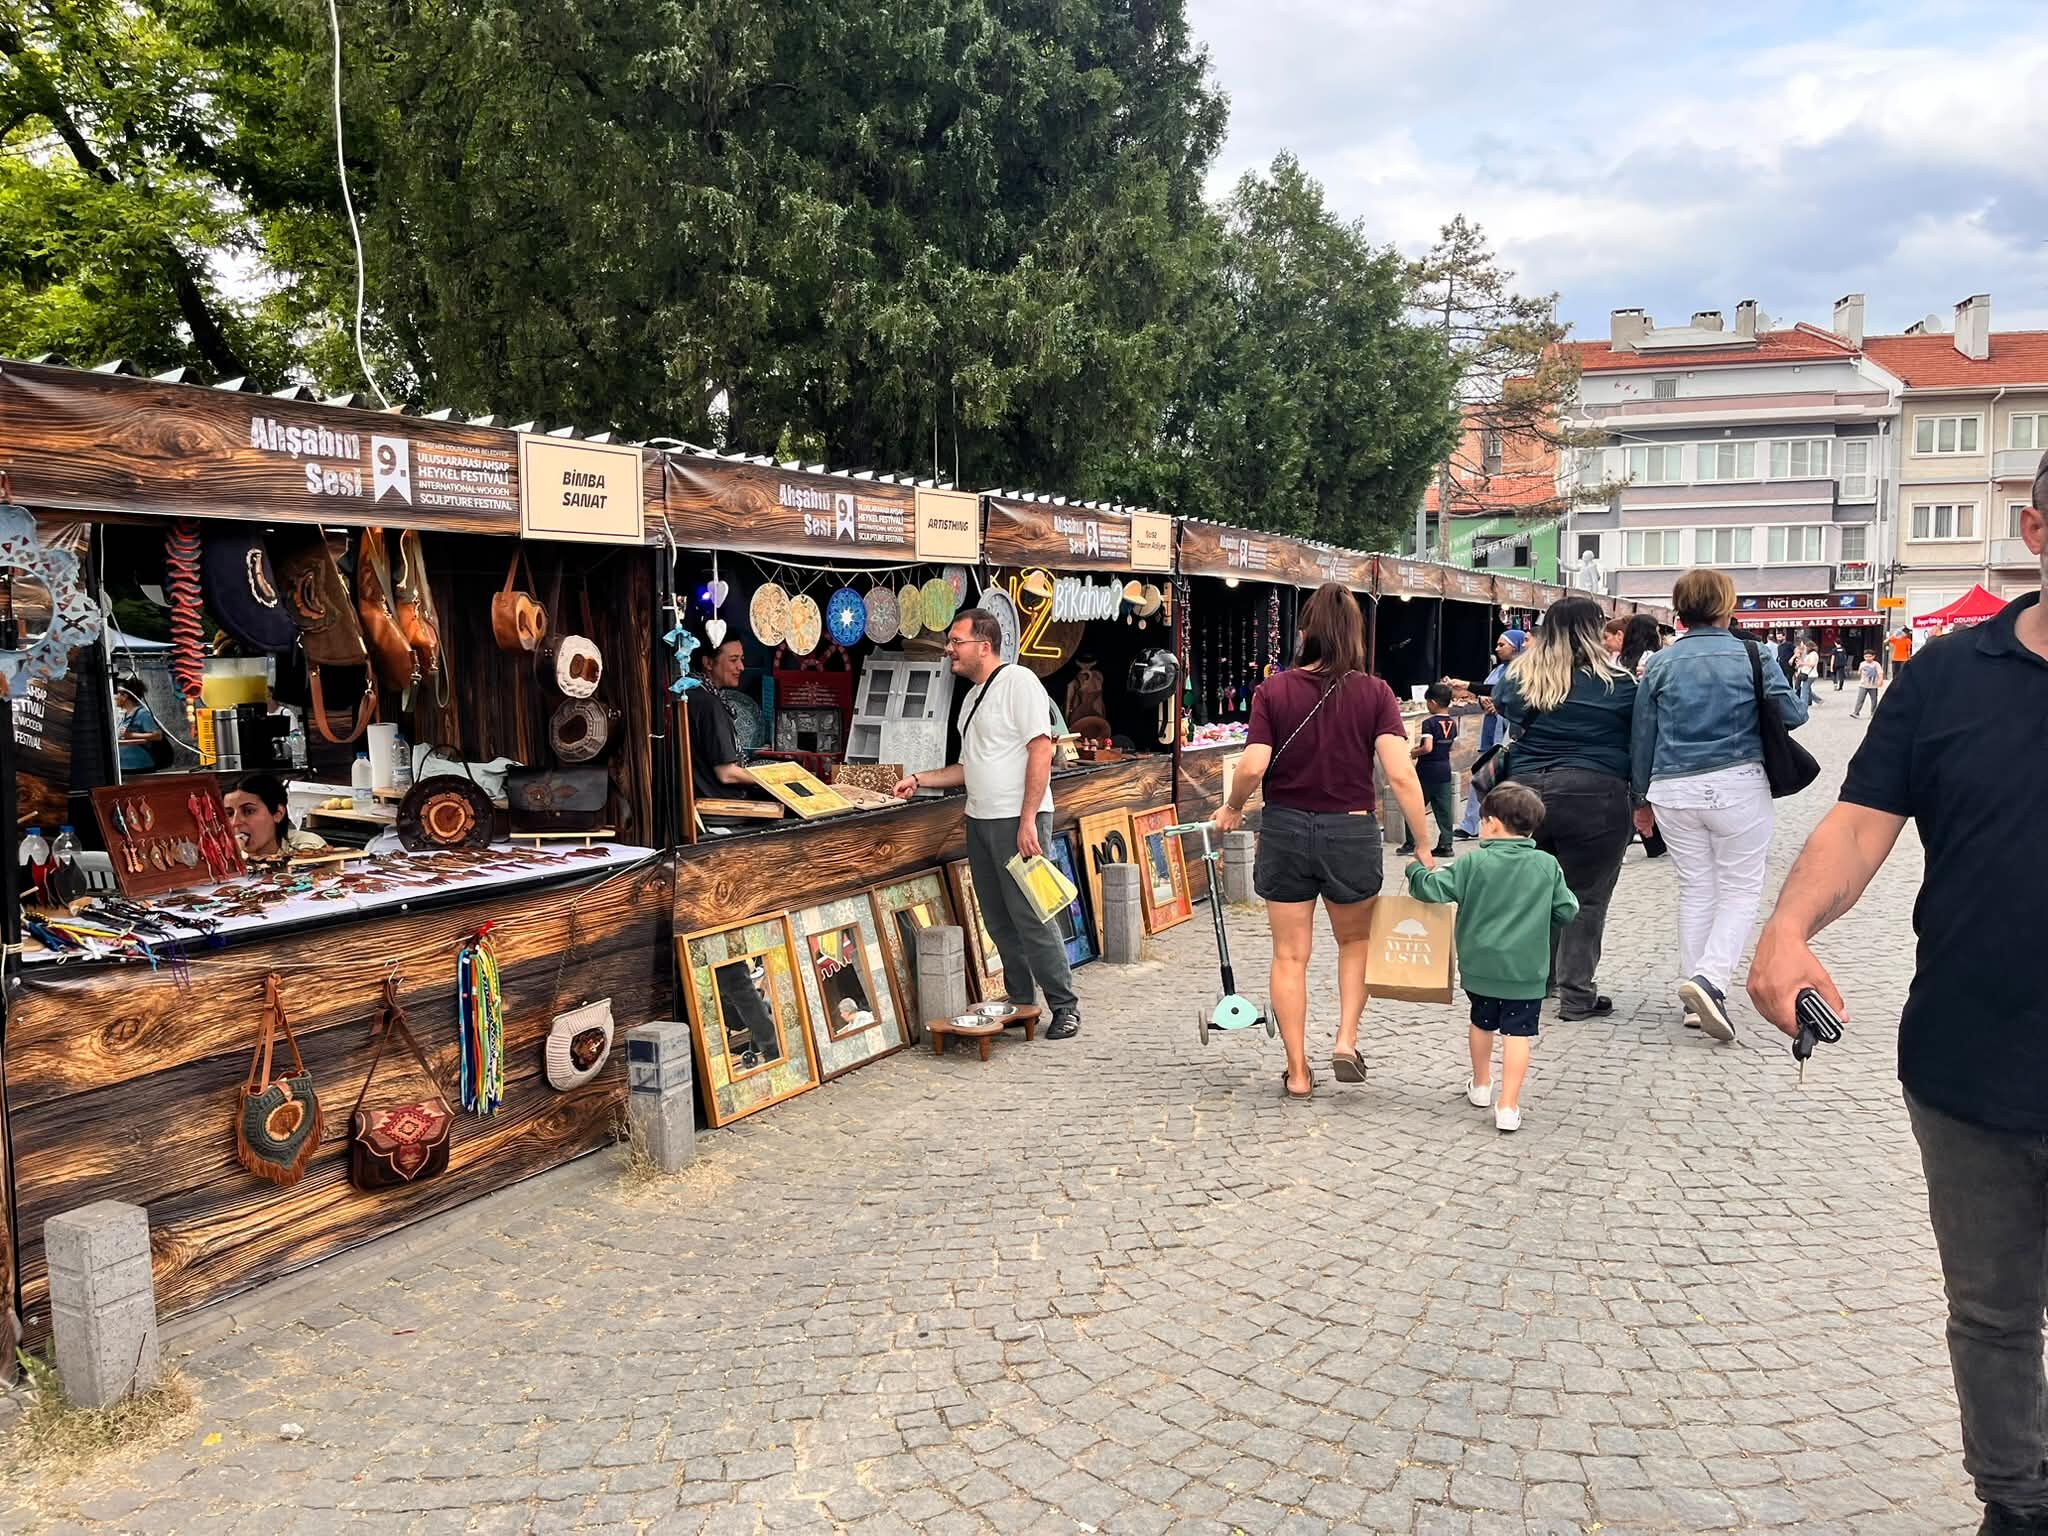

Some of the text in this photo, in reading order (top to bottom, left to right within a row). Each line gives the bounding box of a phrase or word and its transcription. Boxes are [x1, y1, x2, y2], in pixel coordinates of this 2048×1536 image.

[418, 453, 510, 472] ULUSLARARASI AHŞAP
[305, 462, 362, 497] Sesi
[419, 465, 509, 485] HEYKEL FESTİVALİ
[562, 469, 605, 488] BİMBA
[420, 493, 512, 510] SCULPTURE FESTIVAL
[562, 492, 608, 509] SANAT
[927, 517, 969, 532] ARTISTHING
[1791, 597, 1828, 608] BÖREK
[1438, 720, 1454, 739] V
[1384, 951, 1431, 965] USTA
